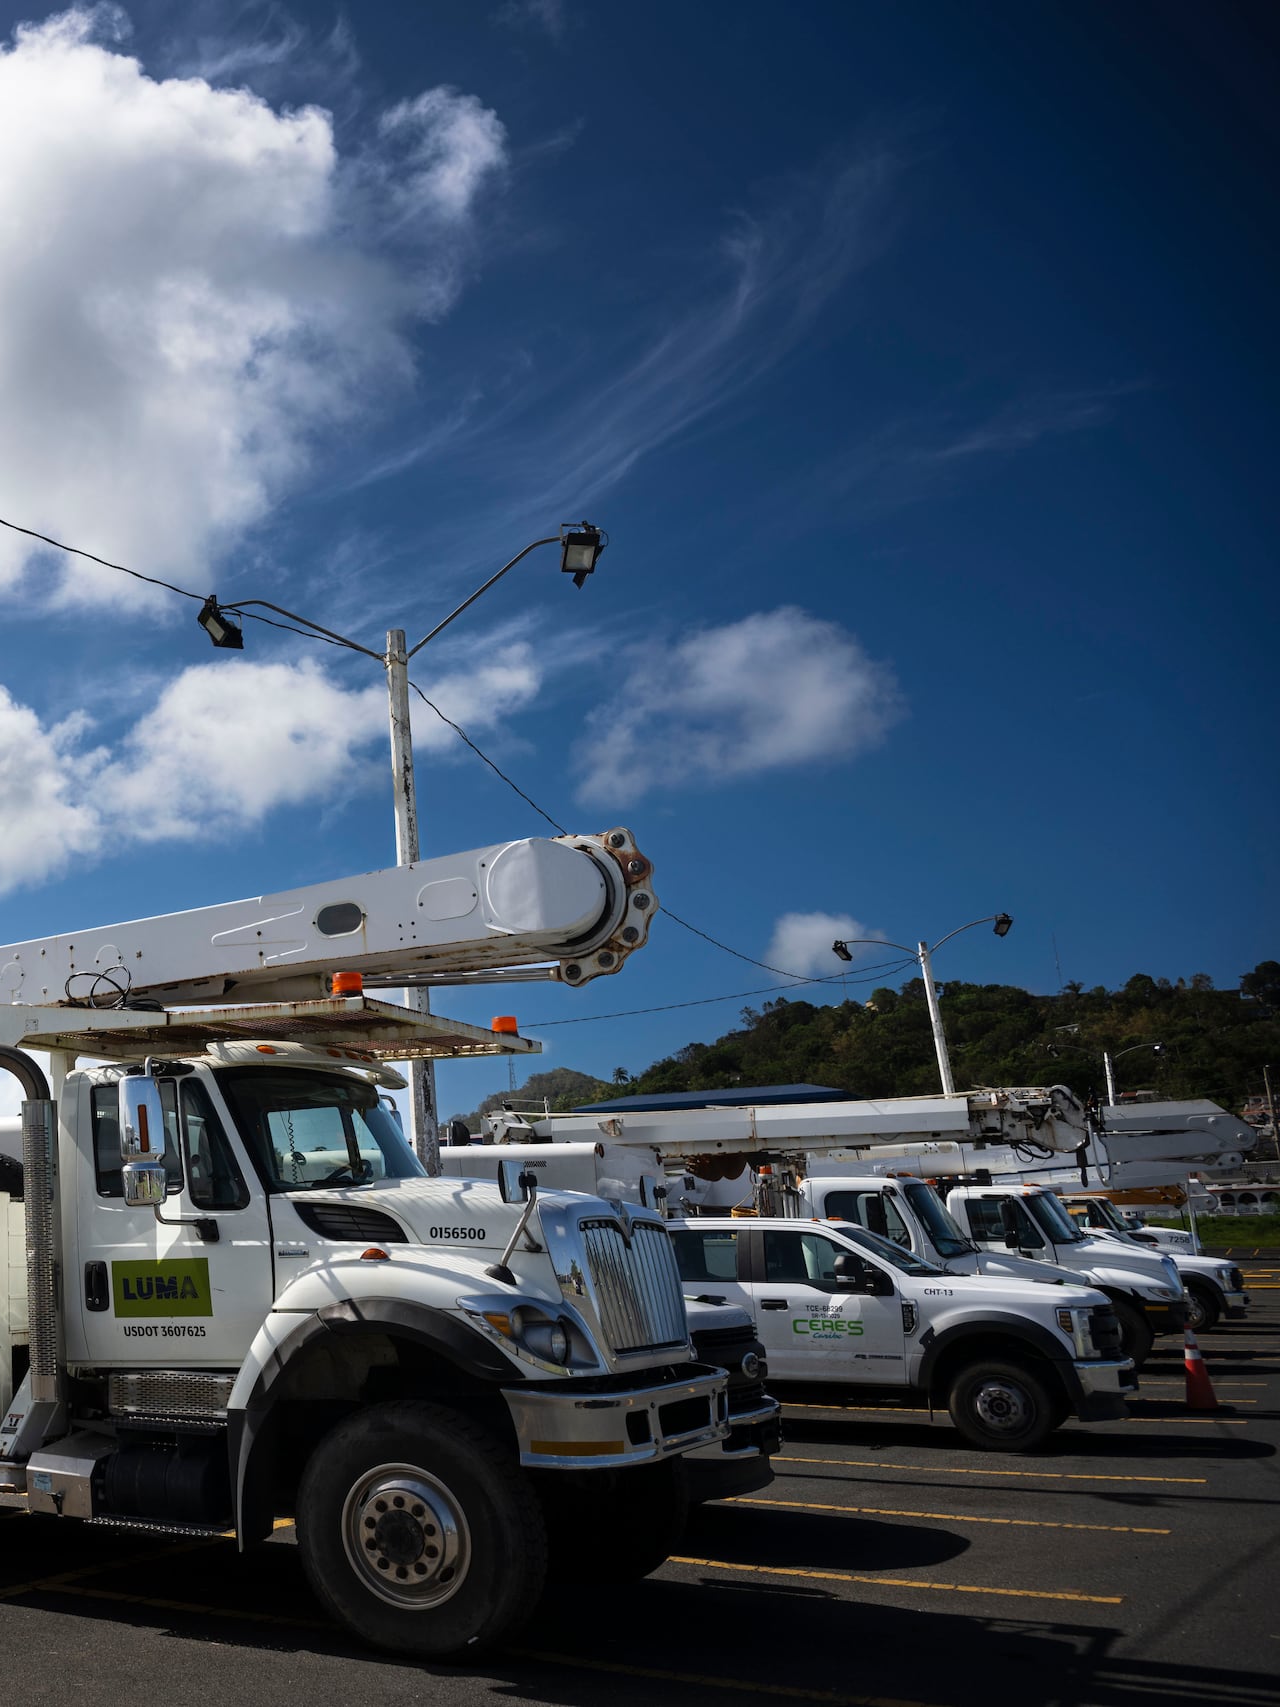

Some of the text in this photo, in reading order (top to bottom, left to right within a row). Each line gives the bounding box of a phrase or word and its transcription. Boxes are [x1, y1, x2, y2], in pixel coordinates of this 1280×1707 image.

[429, 1226, 486, 1241] 0156500
[122, 1275, 199, 1300] LUMA
[924, 1288, 954, 1297] CHT-13
[123, 1326, 207, 1337] USDOT 3607625
[792, 1318, 864, 1336] CERES
